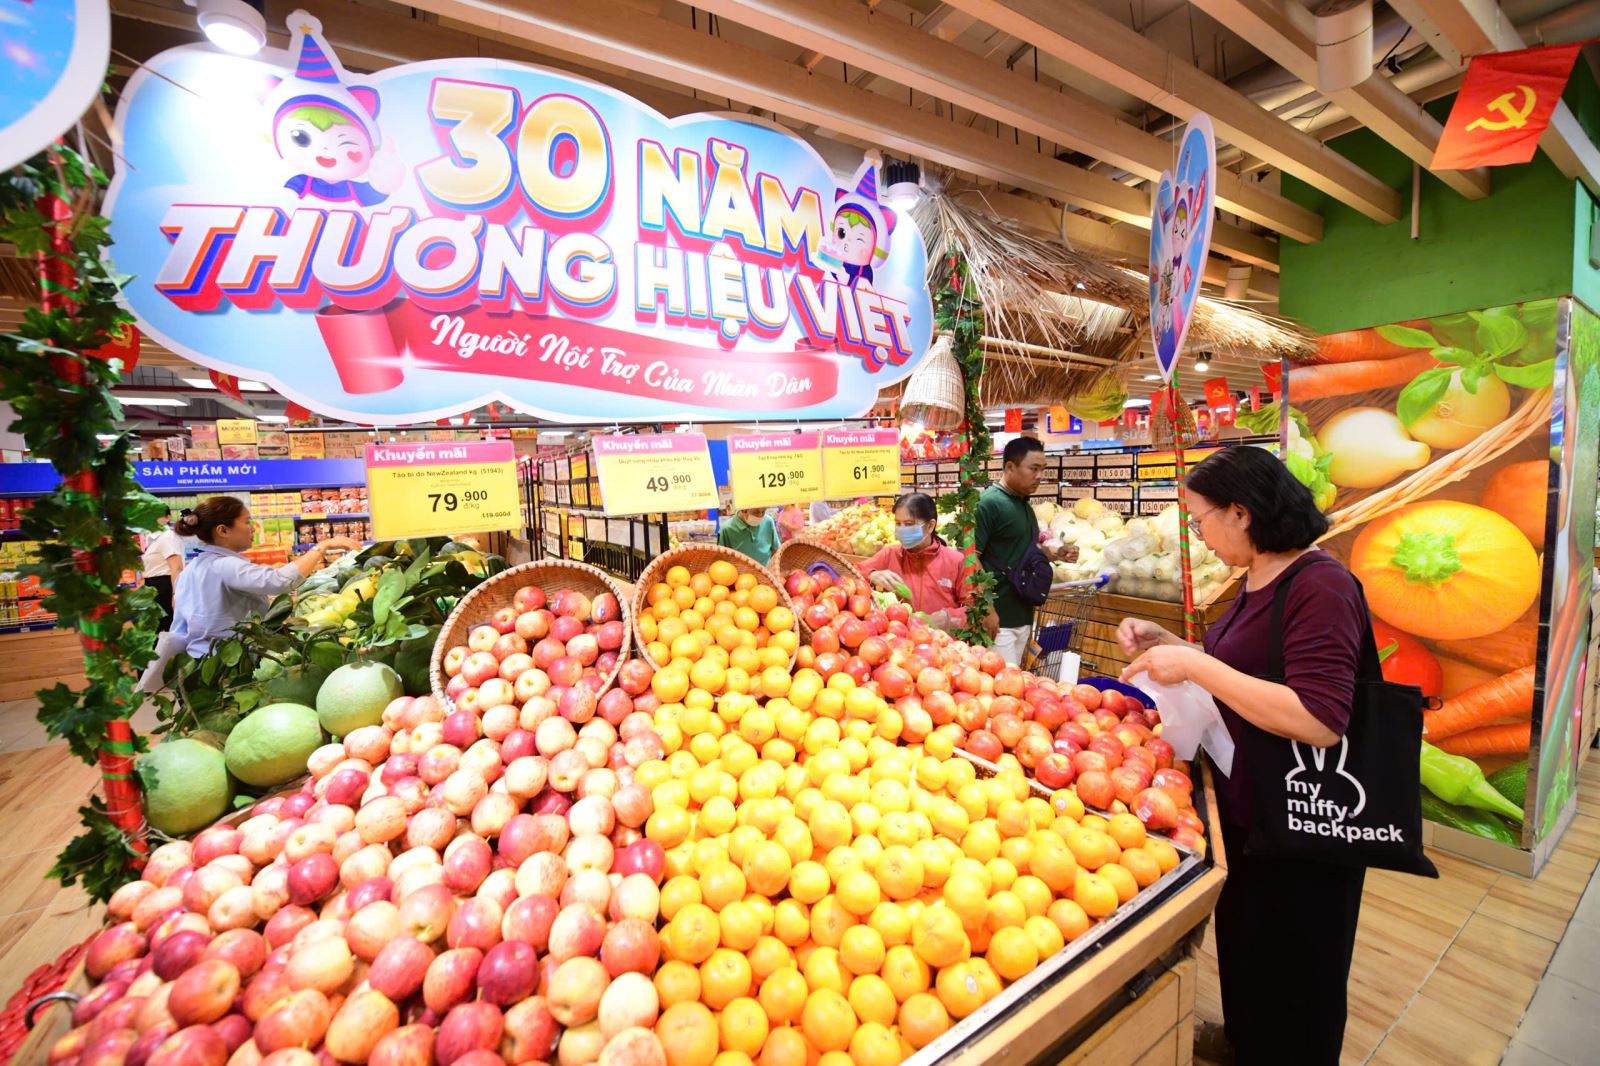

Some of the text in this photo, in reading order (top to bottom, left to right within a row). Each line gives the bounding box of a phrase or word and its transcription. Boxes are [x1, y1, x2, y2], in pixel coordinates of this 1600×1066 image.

[414, 78, 824, 264] 30 NĂM
[154, 203, 911, 370] THƯƠNG HIỆU VIỆT
[430, 314, 812, 398] Người Nội Trợ Của Nhân Dân
[602, 439, 673, 452] Khuyến mãi
[734, 437, 792, 450] Khuyến mãi
[826, 433, 875, 445] Khuyến mãi
[374, 446, 468, 463] Khuyến mãi
[142, 465, 174, 477] SẢN
[227, 463, 257, 475] MỚI
[853, 465, 868, 480] 61
[646, 476, 669, 492] 49
[758, 472, 786, 488] 129
[428, 492, 458, 513] 79
[1286, 779, 1321, 799] my
[1287, 797, 1348, 822] miffy
[1288, 813, 1404, 843] backpack
